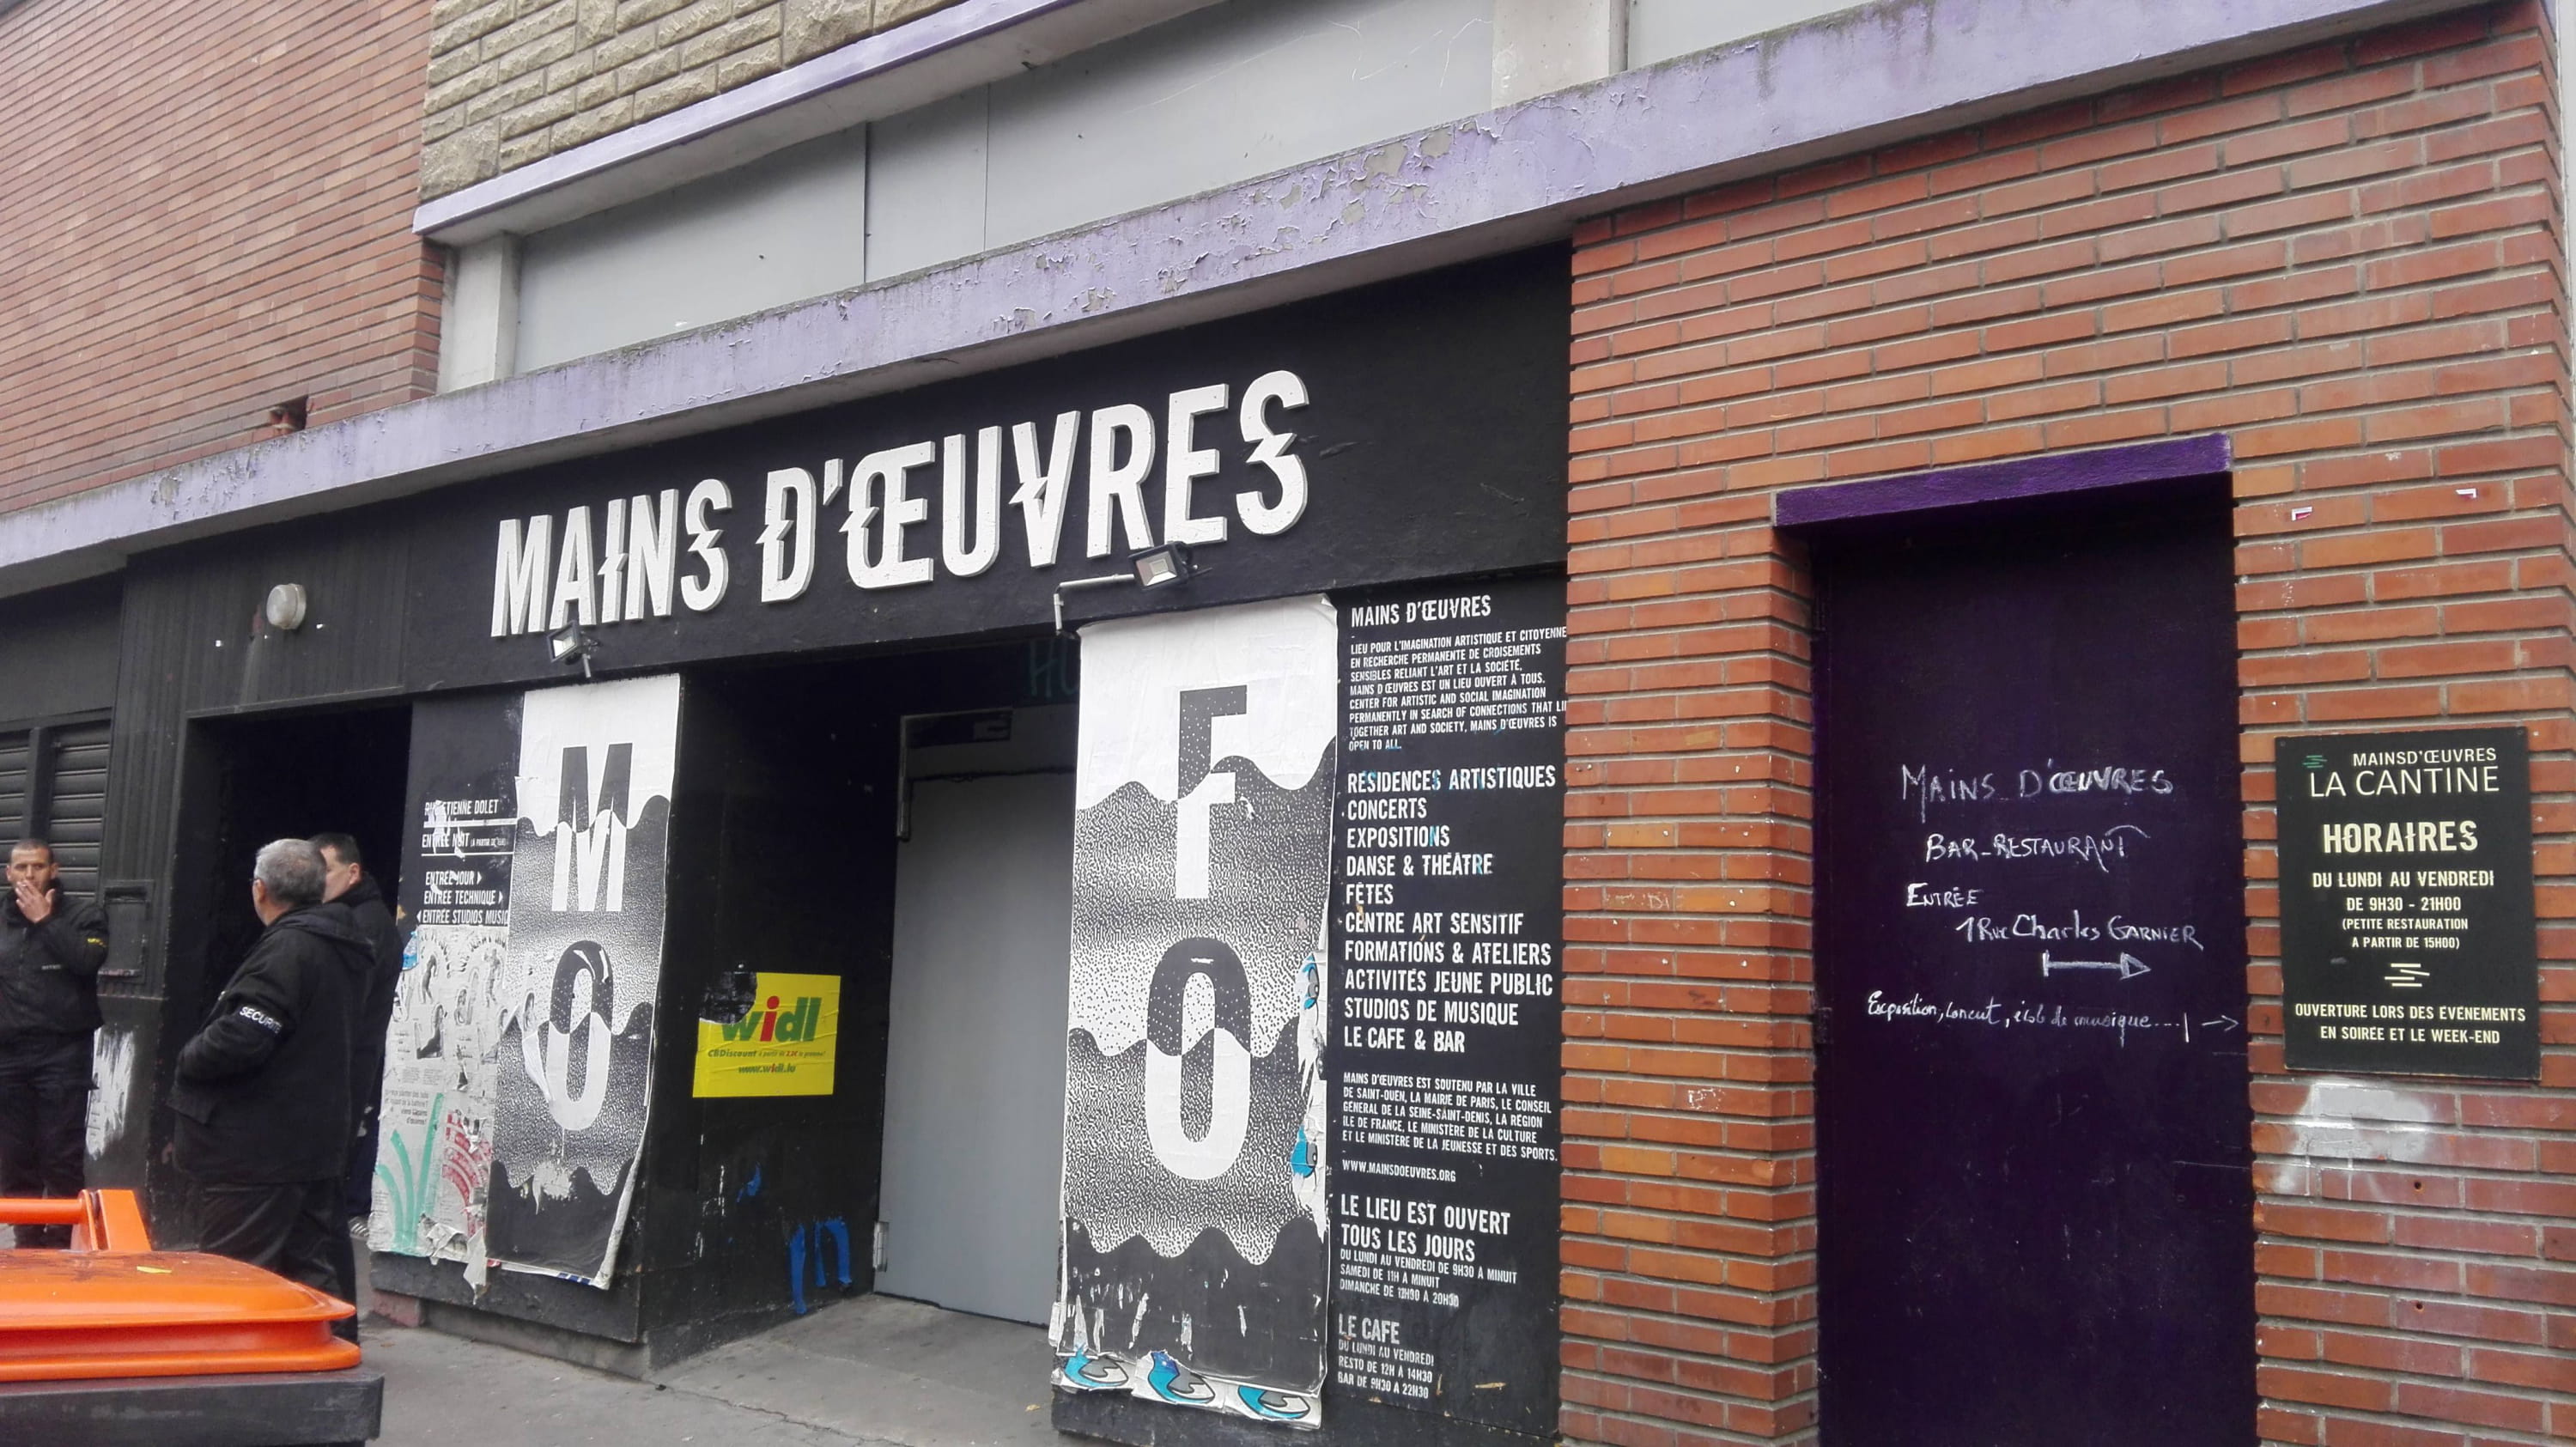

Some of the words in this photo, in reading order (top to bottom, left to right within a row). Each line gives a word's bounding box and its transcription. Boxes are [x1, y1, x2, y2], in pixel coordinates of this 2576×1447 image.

[489, 477, 732, 638] MAINS
[756, 369, 1310, 604] D'ŒUVRES
[1352, 603, 1399, 627] MAINS
[1406, 594, 1491, 623] D'ŒUVRES
[1351, 642, 1367, 654] LIEU
[1370, 641, 1391, 653] POUR
[1454, 631, 1502, 647] ARTISTIQUE
[1505, 630, 1516, 642] ET
[1350, 657, 1360, 668] EN
[1363, 654, 1408, 667] RECHERCHE
[1412, 649, 1465, 663] PERMANENTE
[1468, 648, 1479, 659] DE
[1483, 644, 1540, 658] CROISEMENTS
[1349, 697, 1379, 709] CENTER
[1382, 696, 1397, 707] FOR
[1400, 693, 1437, 707] ARTISTIC
[1439, 692, 1456, 703] AND
[1459, 690, 1488, 702] SOCIAL
[1492, 686, 1546, 701] IMAGINATION
[1449, 764, 1555, 789] ARTISTIQUES
[2310, 771, 2346, 797] LA
[2355, 765, 2499, 795] CANTINE
[474, 799, 499, 815] DOLET
[1347, 797, 1426, 820] CONCERTS
[1346, 824, 1449, 848] EXPOSITIONS
[2323, 820, 2477, 853] HORAIRES
[1346, 854, 1395, 876] DANSE
[1402, 854, 1413, 875] &
[2312, 872, 2331, 887] DU
[2338, 872, 2381, 887] LUNDI
[2390, 871, 2409, 886] AU
[2417, 870, 2494, 886] VENDREDI
[455, 890, 495, 905] TECHNIQUE
[2346, 897, 2363, 910] DE
[2369, 897, 2403, 910] 9H30
[2421, 896, 2461, 910] 21H00
[422, 909, 450, 923] ENTRÉE
[452, 909, 483, 924] STUDIOS
[1345, 911, 1404, 933] CENTRE
[1412, 912, 1443, 933] ART
[1449, 912, 1523, 934] SENSITIF
[2012, 909, 2102, 941] Charles
[2342, 918, 2383, 929] (PETITE
[2386, 918, 2468, 929] RESTAURATION
[1345, 939, 1443, 963] FORMATIONS
[1452, 941, 1463, 963] &
[1472, 942, 1551, 965] ATELIERS
[2362, 936, 2402, 947] PARTIR
[2405, 936, 2419, 947] DE
[2423, 937, 2459, 949] 15H00)
[1345, 968, 1425, 991] ACTIVITÉS
[1433, 970, 1482, 994] JEUNE
[1490, 972, 1552, 995] PUBLIC
[720, 995, 822, 1042] widl
[1344, 996, 1409, 1020] STUDIOS
[1417, 999, 1437, 1021] DE
[1444, 1000, 1518, 1025] MUSIQUE
[2295, 1003, 2367, 1018] OUVERTURE
[2372, 1005, 2403, 1018] LORS
[2409, 1006, 2433, 1018] DES
[1344, 1025, 1362, 1047] LE
[1367, 1026, 1405, 1049] CAFE
[1414, 1028, 1425, 1050] &
[1433, 1030, 1464, 1052] BAR
[2320, 1025, 2336, 1038] EN
[2341, 1026, 2385, 1040] SOIRÉE
[2390, 1027, 2404, 1041] ET
[2410, 1028, 2425, 1041] LE
[2431, 1029, 2500, 1043] WEEK-END
[1343, 1072, 1368, 1084] MAINS
[1371, 1073, 1413, 1087] D'ŒUVRES
[1416, 1076, 1431, 1088] EST
[1434, 1078, 1473, 1091] SOUTENU
[1475, 1080, 1492, 1093] PAR
[1496, 1082, 1507, 1094] LA
[1511, 1083, 1535, 1097] VILLE
[1343, 1086, 1353, 1097] DE
[1356, 1087, 1406, 1103] SAINT-OUEN,
[1410, 1091, 1420, 1103] LA
[1424, 1091, 1453, 1105] MAIRIE
[1455, 1094, 1467, 1106] DE
[1470, 1095, 1498, 1110] PARIS,
[1501, 1097, 1511, 1110] LE
[1515, 1098, 1551, 1113] CONSEIL
[1342, 1129, 1352, 1140] ET
[1355, 1130, 1364, 1142] LE
[1413, 1136, 1424, 1148] DE
[1427, 1137, 1437, 1149] LA
[1441, 1139, 1482, 1153] JEUNESSE
[1485, 1142, 1497, 1155] ET
[1500, 1144, 1516, 1157] DES
[1521, 1146, 1557, 1160] SPORTS.
[1342, 1158, 1455, 1182] WWW.MAINSDOEUVRES.ORG
[1340, 1193, 1358, 1216] LE
[1366, 1196, 1400, 1221] LIEU
[1407, 1201, 1436, 1225] EST
[1443, 1205, 1510, 1234] OUVERT
[1341, 1223, 1381, 1249] TOUS
[1388, 1229, 1416, 1254] LES
[1424, 1233, 1474, 1262] JOURS
[1340, 1248, 1351, 1260] DU
[1353, 1249, 1376, 1264] LUNDI
[1380, 1254, 1391, 1266] AU
[1394, 1255, 1435, 1272] VENDREDI
[1437, 1261, 1449, 1274] DE
[1452, 1263, 1473, 1278] 9H30
[1486, 1268, 1516, 1283] MINUIT
[1340, 1263, 1370, 1278] SAMEDI
[1372, 1268, 1382, 1280] DE
[1411, 1273, 1439, 1288] MINUIT
[1339, 1313, 1356, 1337] LE
[1361, 1317, 1400, 1344] CAFE
